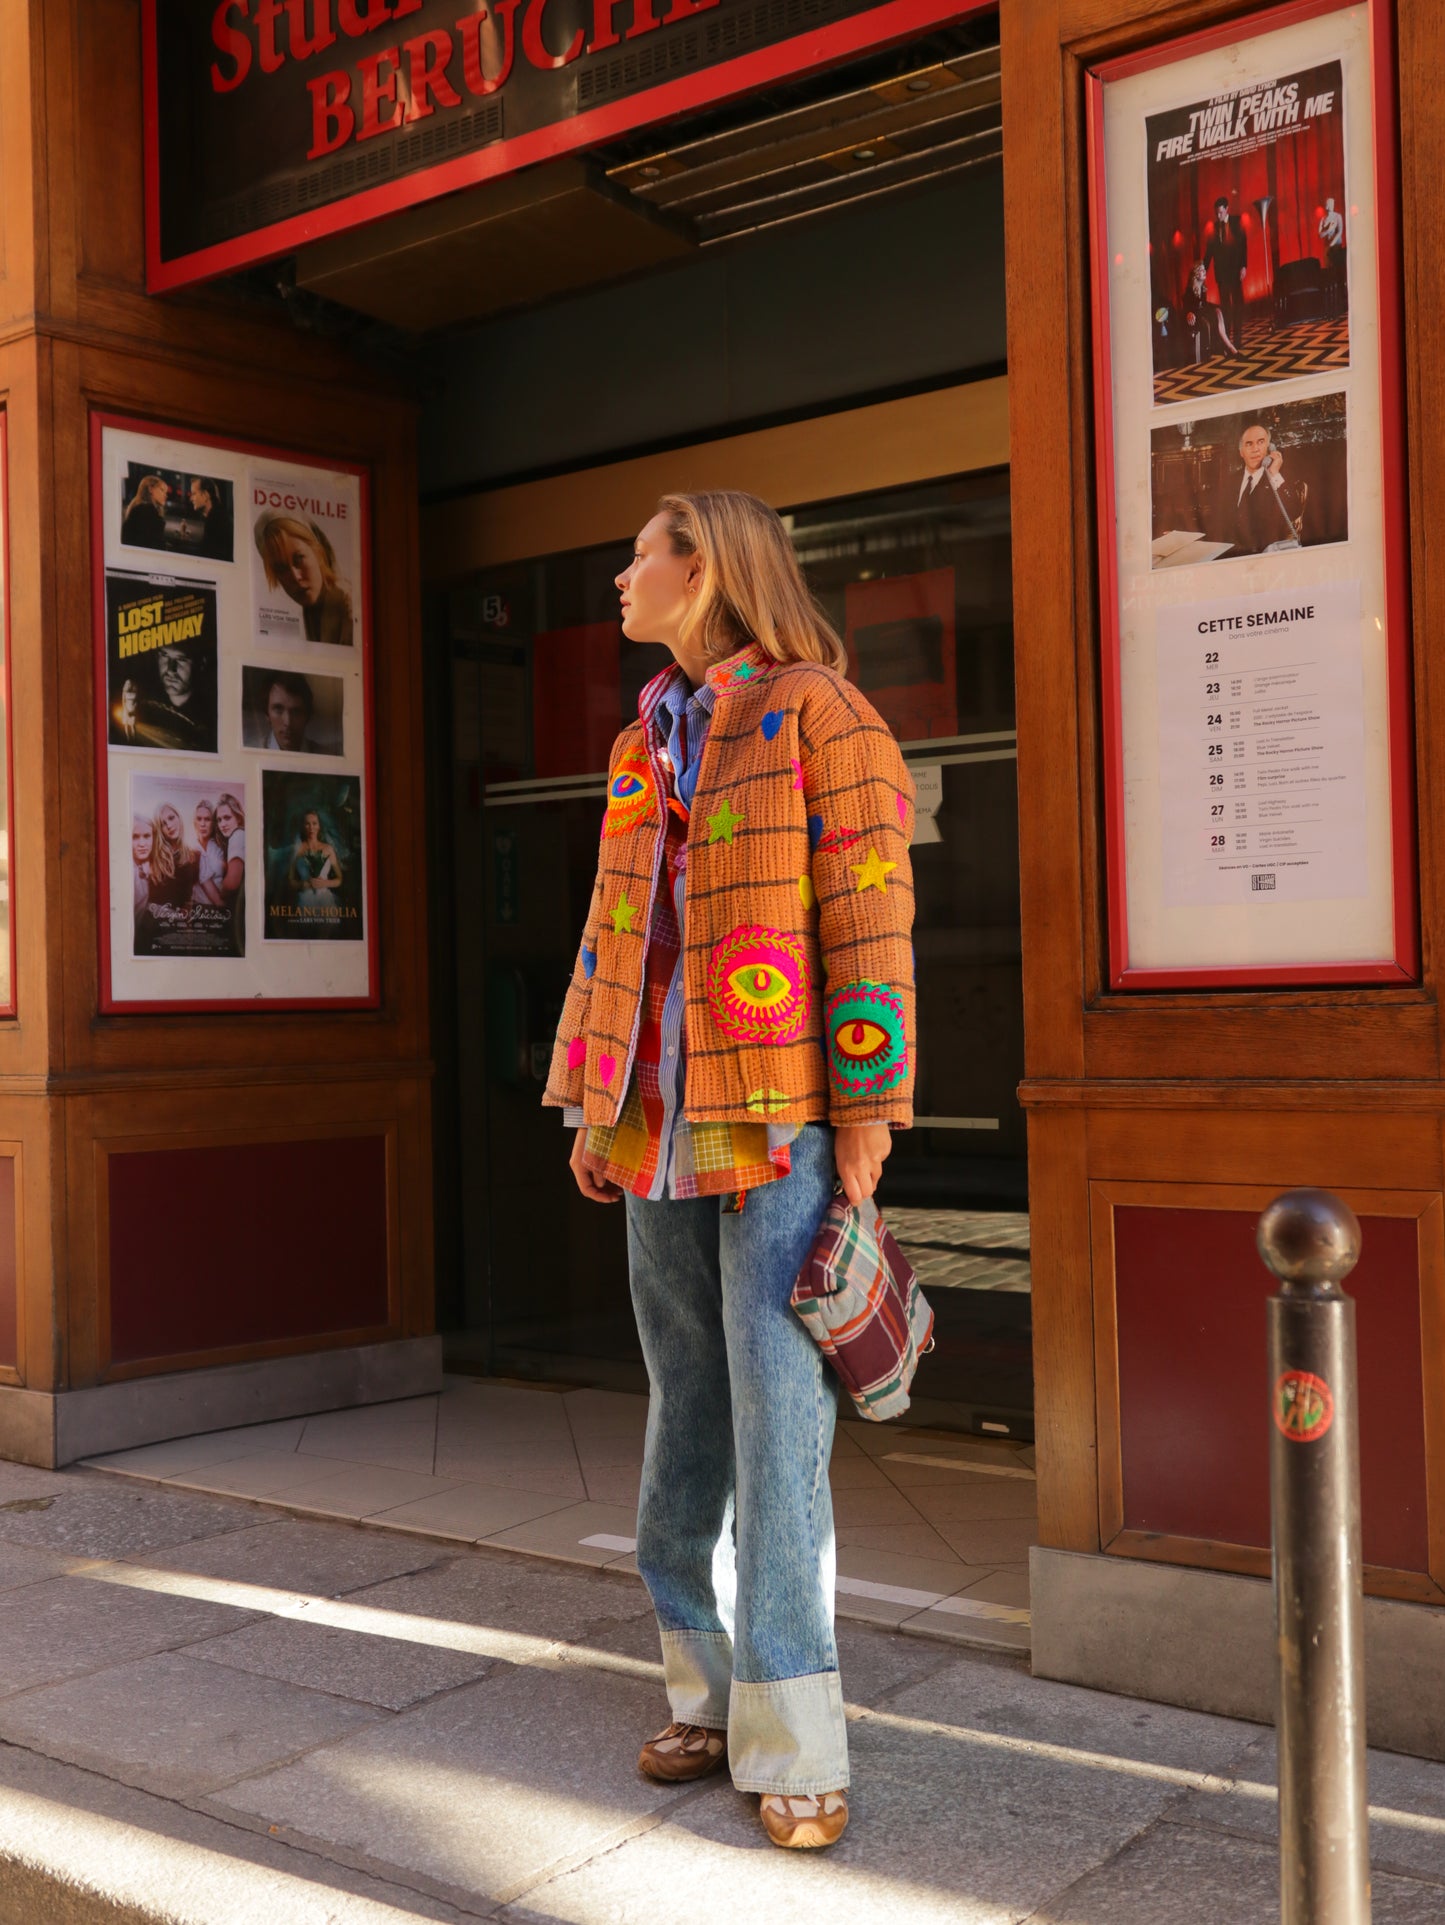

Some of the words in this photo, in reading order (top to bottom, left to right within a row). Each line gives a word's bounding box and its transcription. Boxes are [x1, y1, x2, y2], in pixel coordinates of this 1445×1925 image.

[1189, 101, 1234, 133] TWIN
[1238, 82, 1299, 118] PEAKS
[1156, 132, 1194, 162] FIRE
[1200, 116, 1248, 148] WALK
[1254, 101, 1299, 133] WITH
[1304, 91, 1334, 119] ME
[254, 488, 348, 520] DOGVILLE
[118, 601, 165, 635] LOST
[1198, 616, 1244, 634] CETTE
[1246, 606, 1316, 627] SEMAINE
[118, 613, 205, 660] HIGHWAY
[1205, 652, 1220, 664] 22
[1206, 682, 1221, 694] 23
[1207, 714, 1223, 725] 24
[1208, 745, 1223, 756] 25
[1209, 774, 1224, 785] 26
[919, 783, 938, 791] COLIS
[1211, 805, 1224, 816] 27
[1211, 835, 1226, 846] 28
[269, 904, 358, 919] MELANCHOLIA
